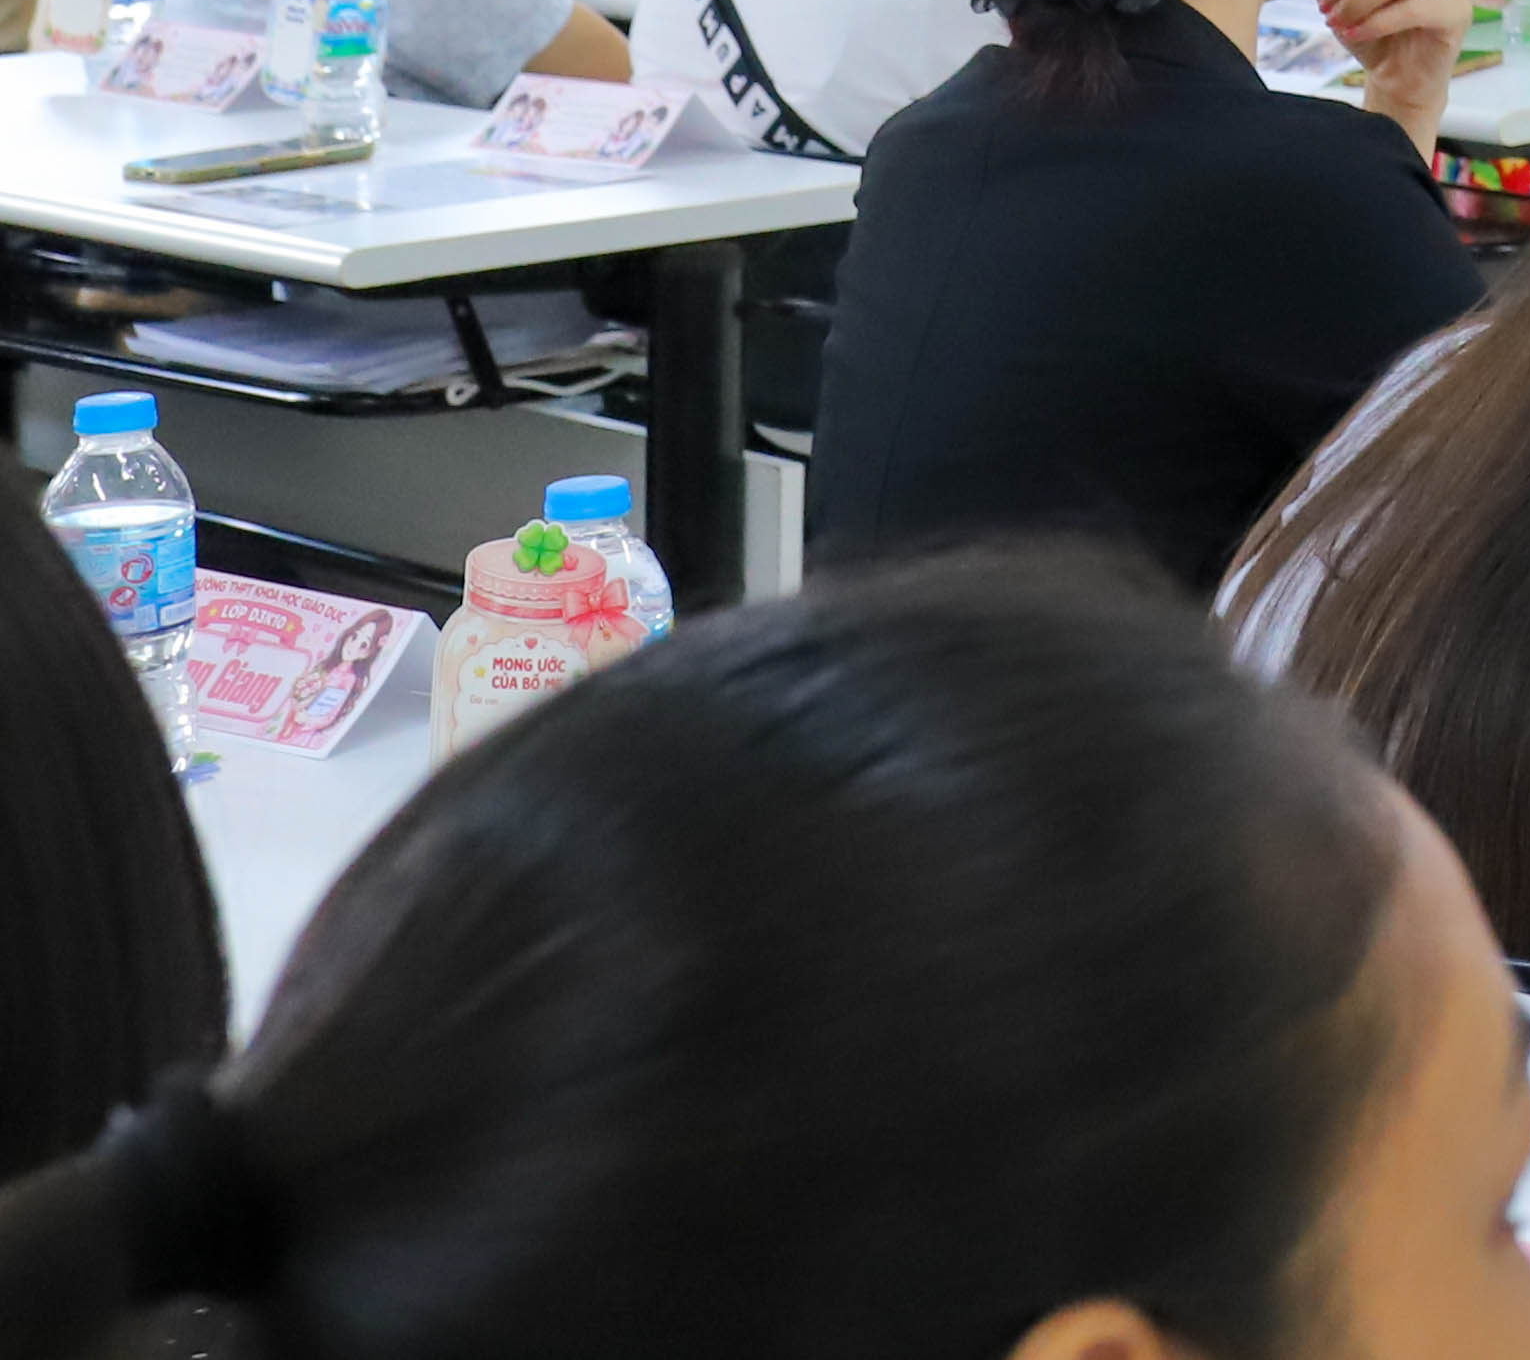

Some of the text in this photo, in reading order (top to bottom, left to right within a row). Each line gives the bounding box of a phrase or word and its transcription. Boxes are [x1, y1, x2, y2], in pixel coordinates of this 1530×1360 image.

[220, 600, 288, 629] LỚP D3K10
[230, 580, 255, 596] THPT
[255, 583, 281, 601] KHOA
[301, 594, 325, 616] GIÁO
[324, 605, 348, 624] DỤC
[492, 657, 533, 672] MONG
[207, 658, 283, 714] Giang
[491, 672, 518, 690] CỦA
[522, 673, 540, 690] BỐ
